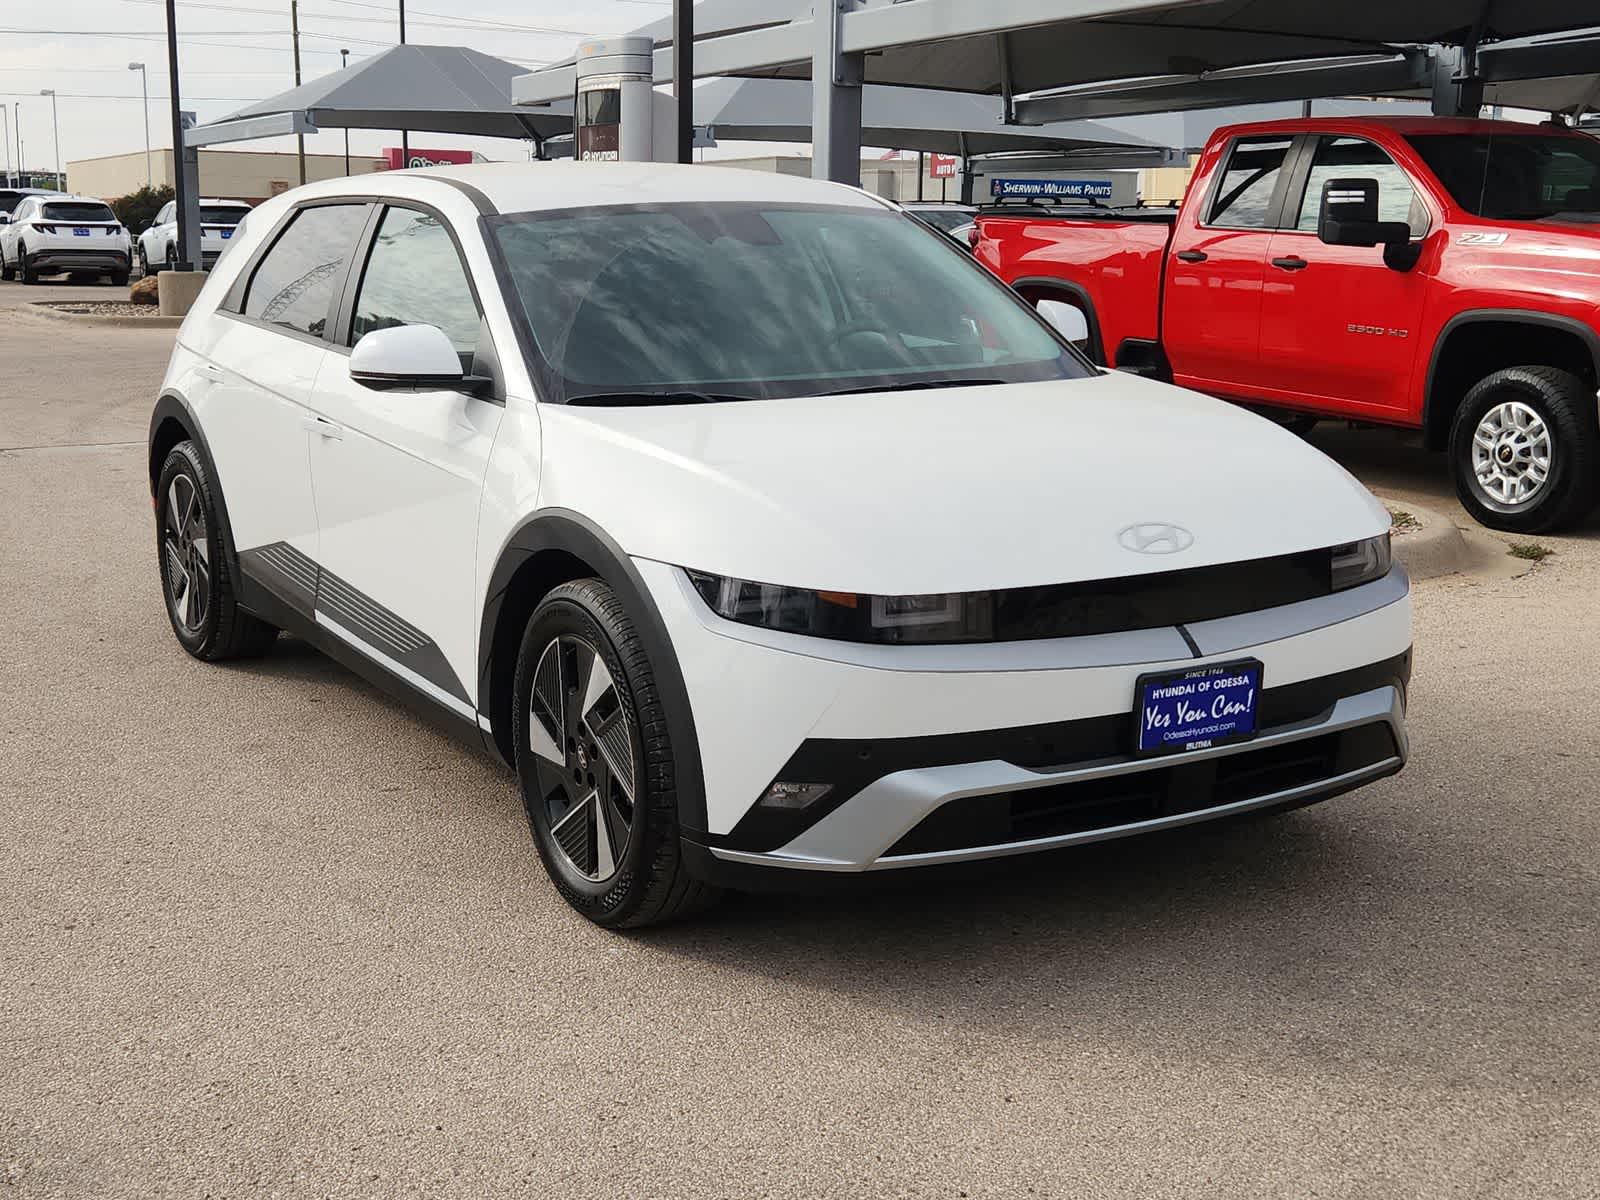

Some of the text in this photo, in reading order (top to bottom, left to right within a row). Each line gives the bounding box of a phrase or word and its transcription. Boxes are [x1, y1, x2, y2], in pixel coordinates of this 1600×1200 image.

[1084, 184, 1111, 196] PAINTS
[1184, 670, 1207, 680] SINCE
[1152, 675, 1249, 700] HYUNDAI OF ODESSA
[1146, 688, 1254, 730] Yes You Can!
